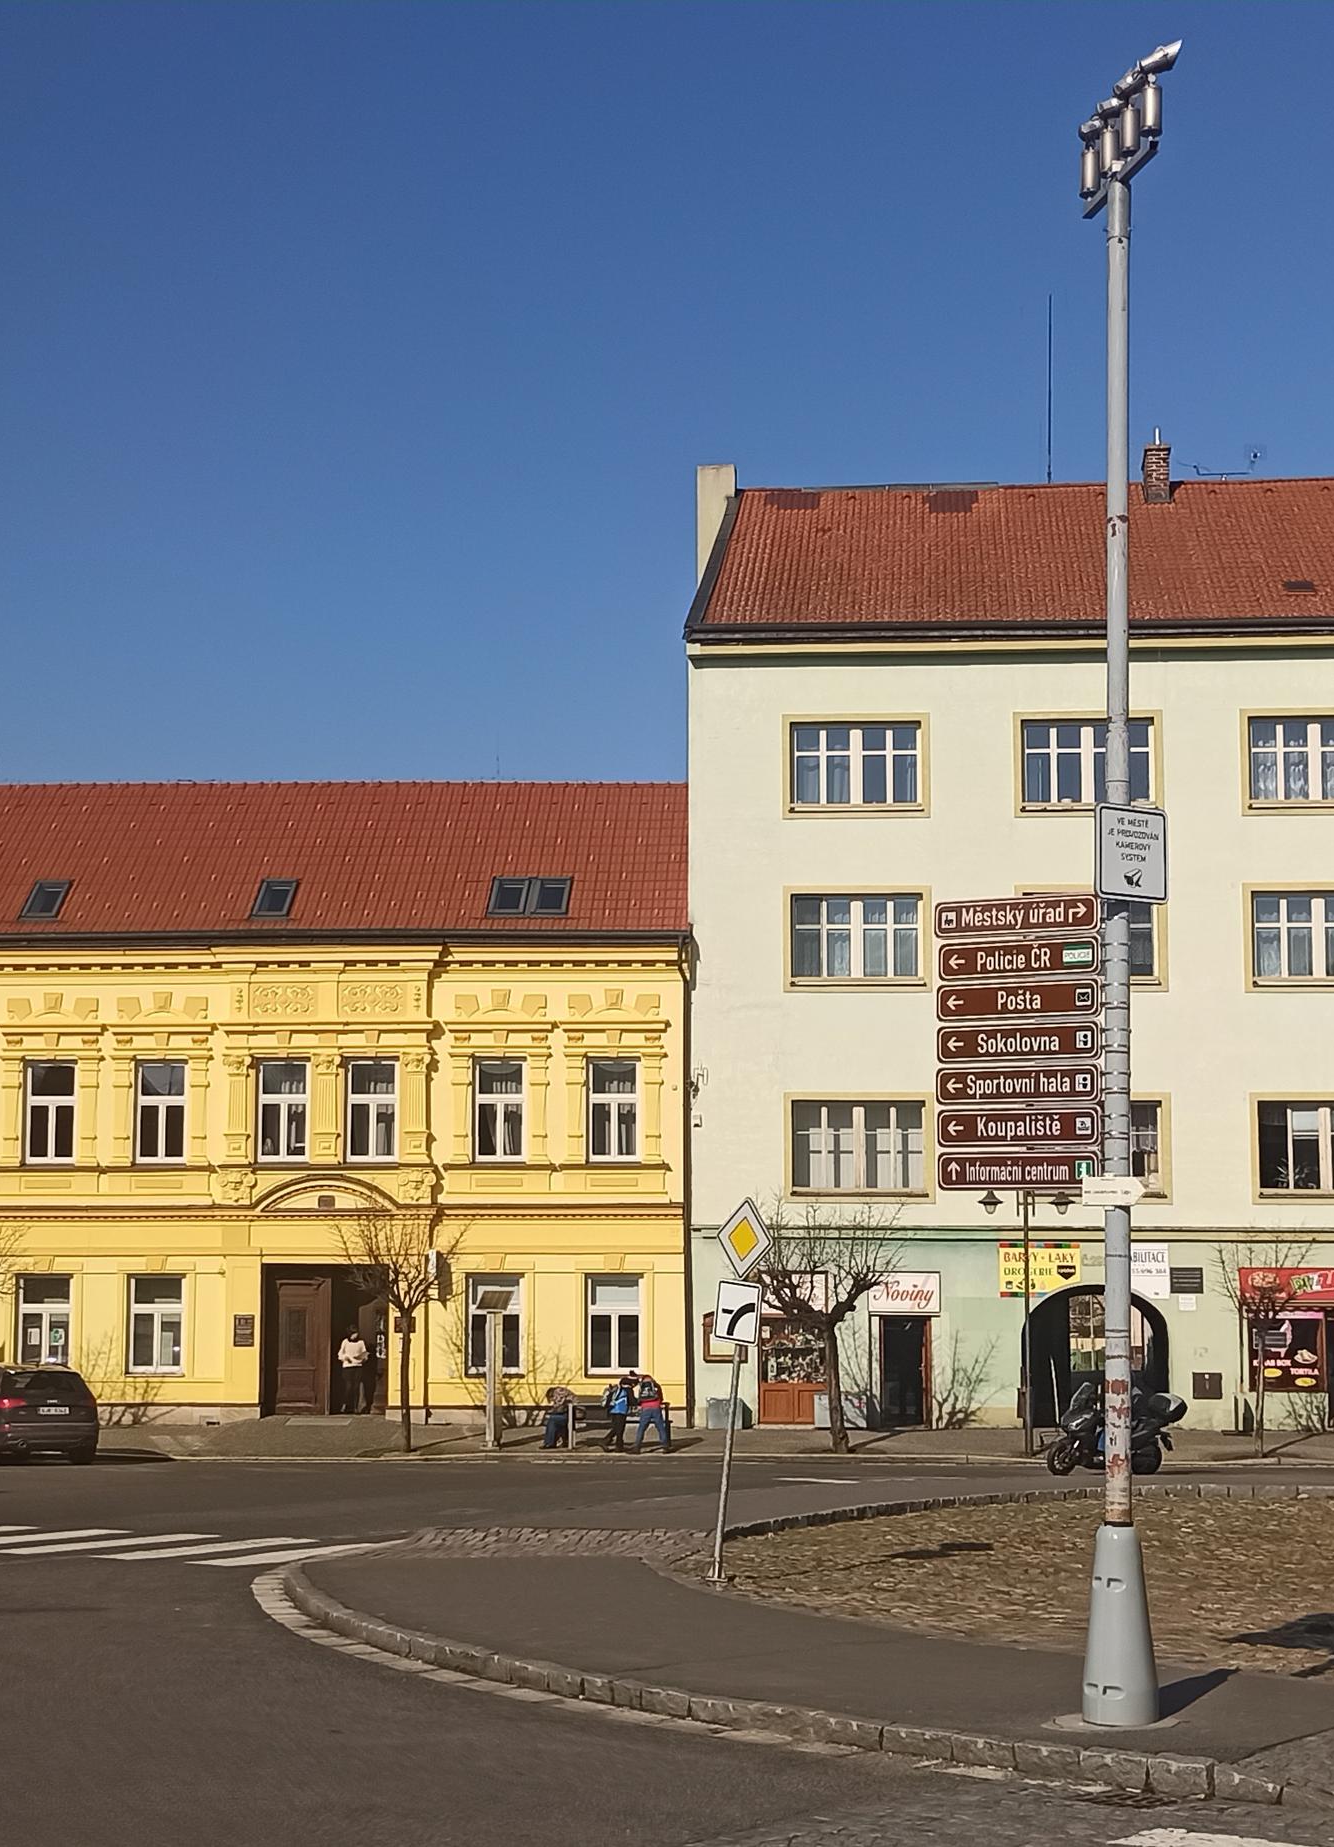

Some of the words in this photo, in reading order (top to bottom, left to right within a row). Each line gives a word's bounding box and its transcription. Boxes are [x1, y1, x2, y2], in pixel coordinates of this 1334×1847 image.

[1117, 817, 1125, 826] VE
[961, 904, 1024, 930] Městský
[1029, 902, 1065, 924] úřad
[977, 950, 1026, 972] Policie
[1031, 943, 1051, 968] ČR
[997, 989, 1042, 1011] Pošta
[977, 1032, 1060, 1054] Sokolovna
[966, 1072, 1035, 1100] Sportovní
[1040, 1072, 1070, 1093] hala
[976, 1114, 1061, 1141] Koupaliště
[966, 1160, 1022, 1182] Informační
[1025, 1161, 1069, 1182] centrum
[1003, 1251, 1039, 1263] BARY
[1048, 1252, 1076, 1263] LAKY
[873, 1280, 934, 1310] Noviny
